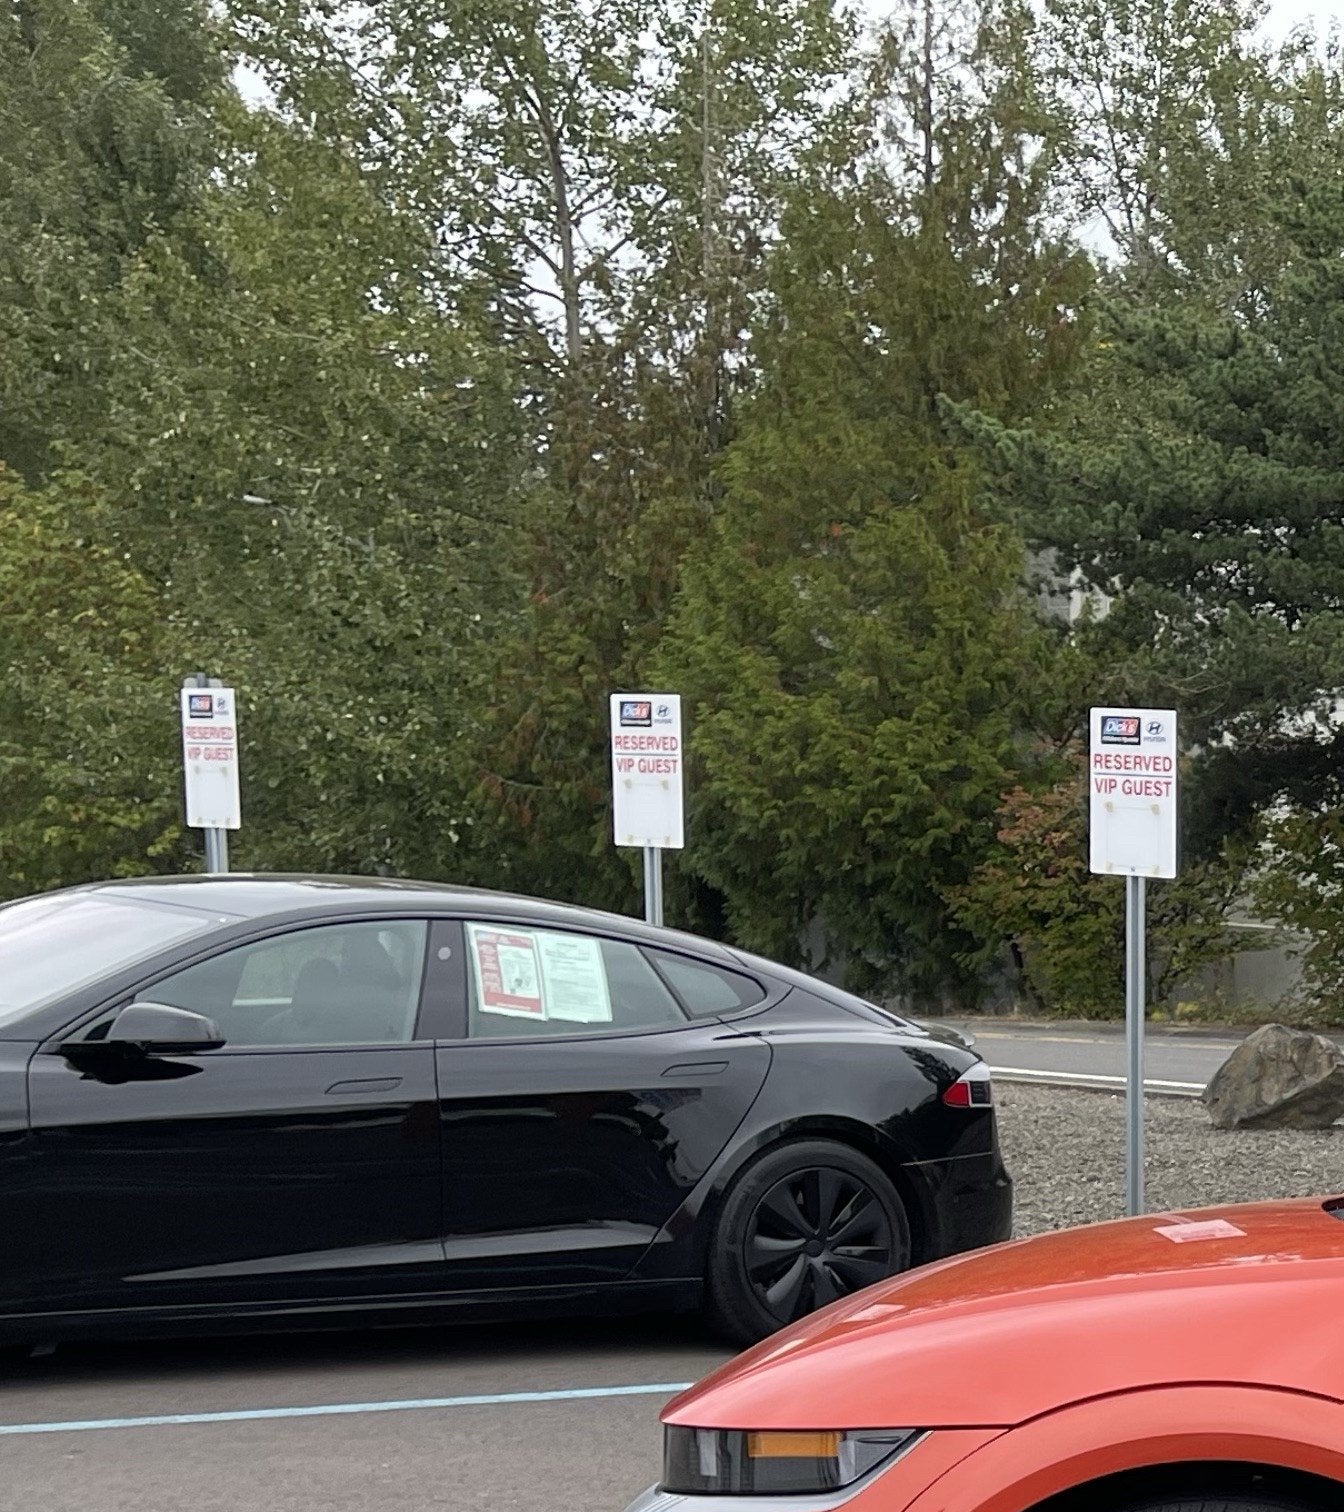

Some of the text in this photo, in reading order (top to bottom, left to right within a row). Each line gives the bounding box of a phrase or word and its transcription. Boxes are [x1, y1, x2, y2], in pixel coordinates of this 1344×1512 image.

[614, 735, 678, 751] RESERVED
[616, 758, 678, 774] VIP GUEST
[1093, 753, 1172, 772] RESERVED
[1094, 778, 1172, 797] VIP GUEST
